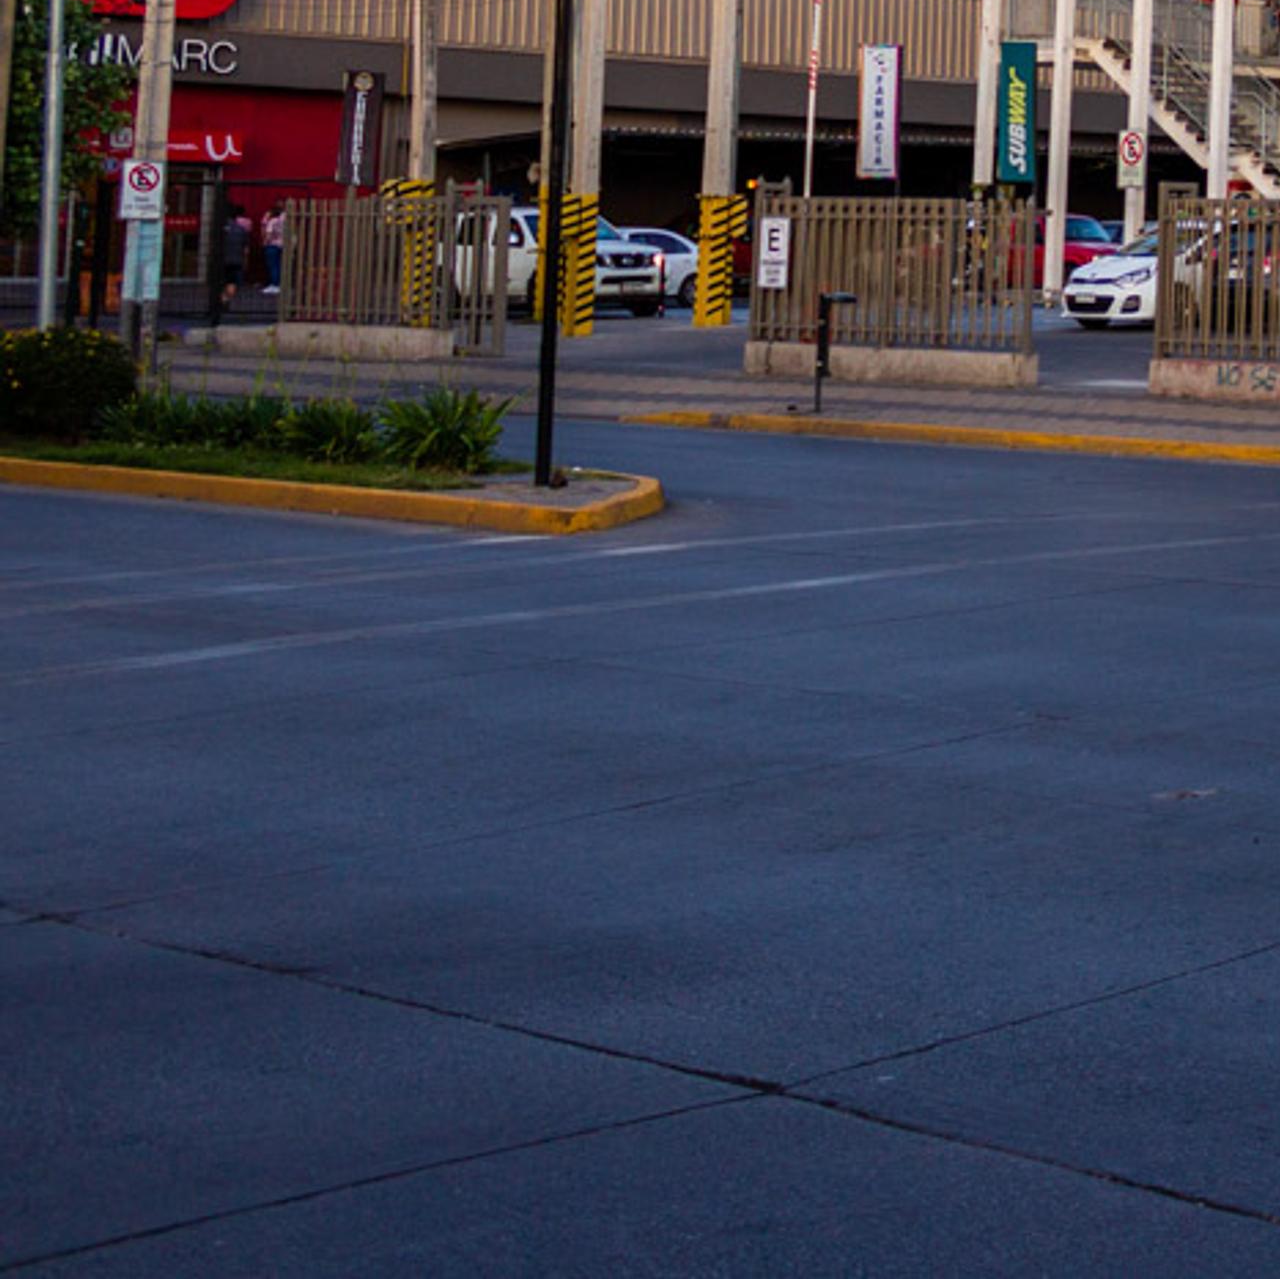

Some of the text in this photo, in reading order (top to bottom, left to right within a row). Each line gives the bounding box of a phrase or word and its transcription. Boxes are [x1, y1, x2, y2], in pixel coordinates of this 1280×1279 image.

[874, 75, 885, 166] FARMACIA
[1008, 66, 1027, 174] SUBWAY
[768, 228, 781, 252] E
